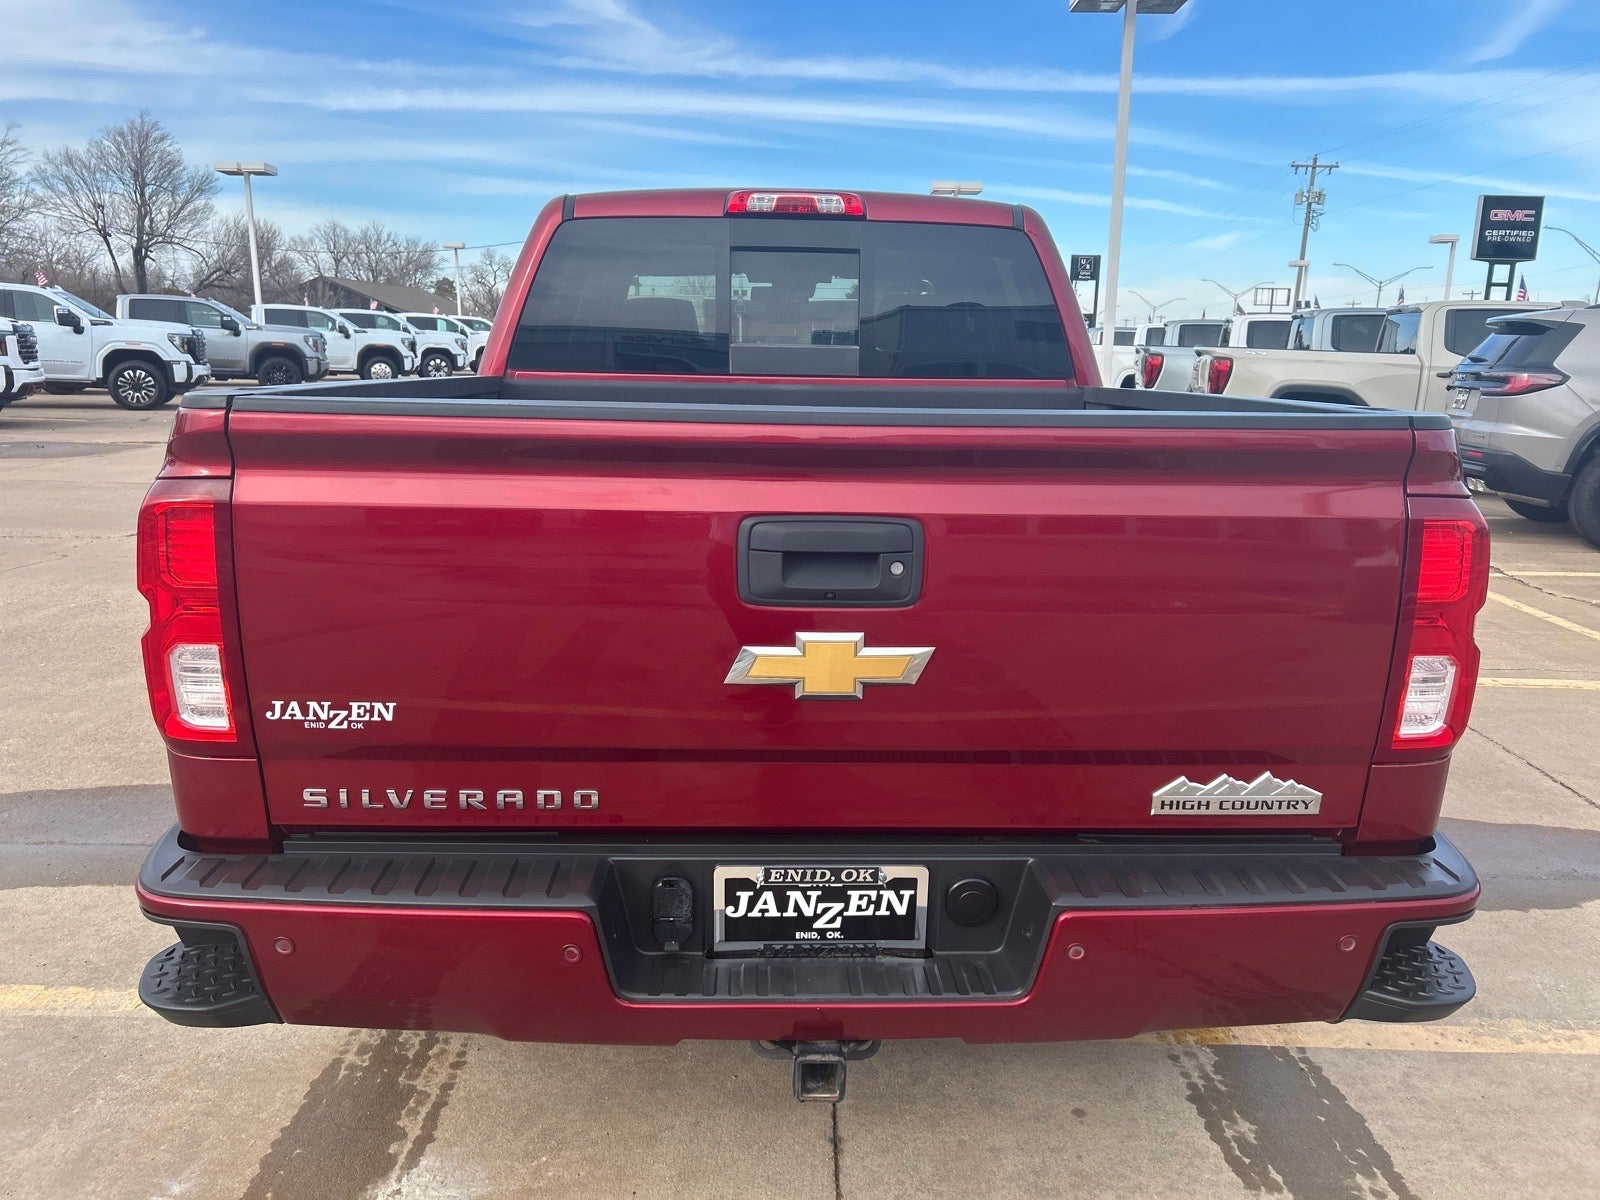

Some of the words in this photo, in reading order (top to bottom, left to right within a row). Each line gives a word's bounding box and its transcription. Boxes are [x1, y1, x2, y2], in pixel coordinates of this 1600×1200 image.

[1490, 209, 1536, 221] GMC
[1485, 229, 1535, 237] CERTIFIED
[265, 700, 397, 729] JANZEN
[304, 721, 326, 729] ENID
[302, 788, 599, 810] SILVERADO
[1160, 800, 1211, 811] HIGH
[1218, 800, 1314, 811] COUNTRY
[768, 868, 836, 883] ENID,
[840, 868, 876, 882] OK
[725, 890, 914, 929] JANZEN
[795, 931, 821, 940] ENID,
[826, 931, 845, 939] OK.
